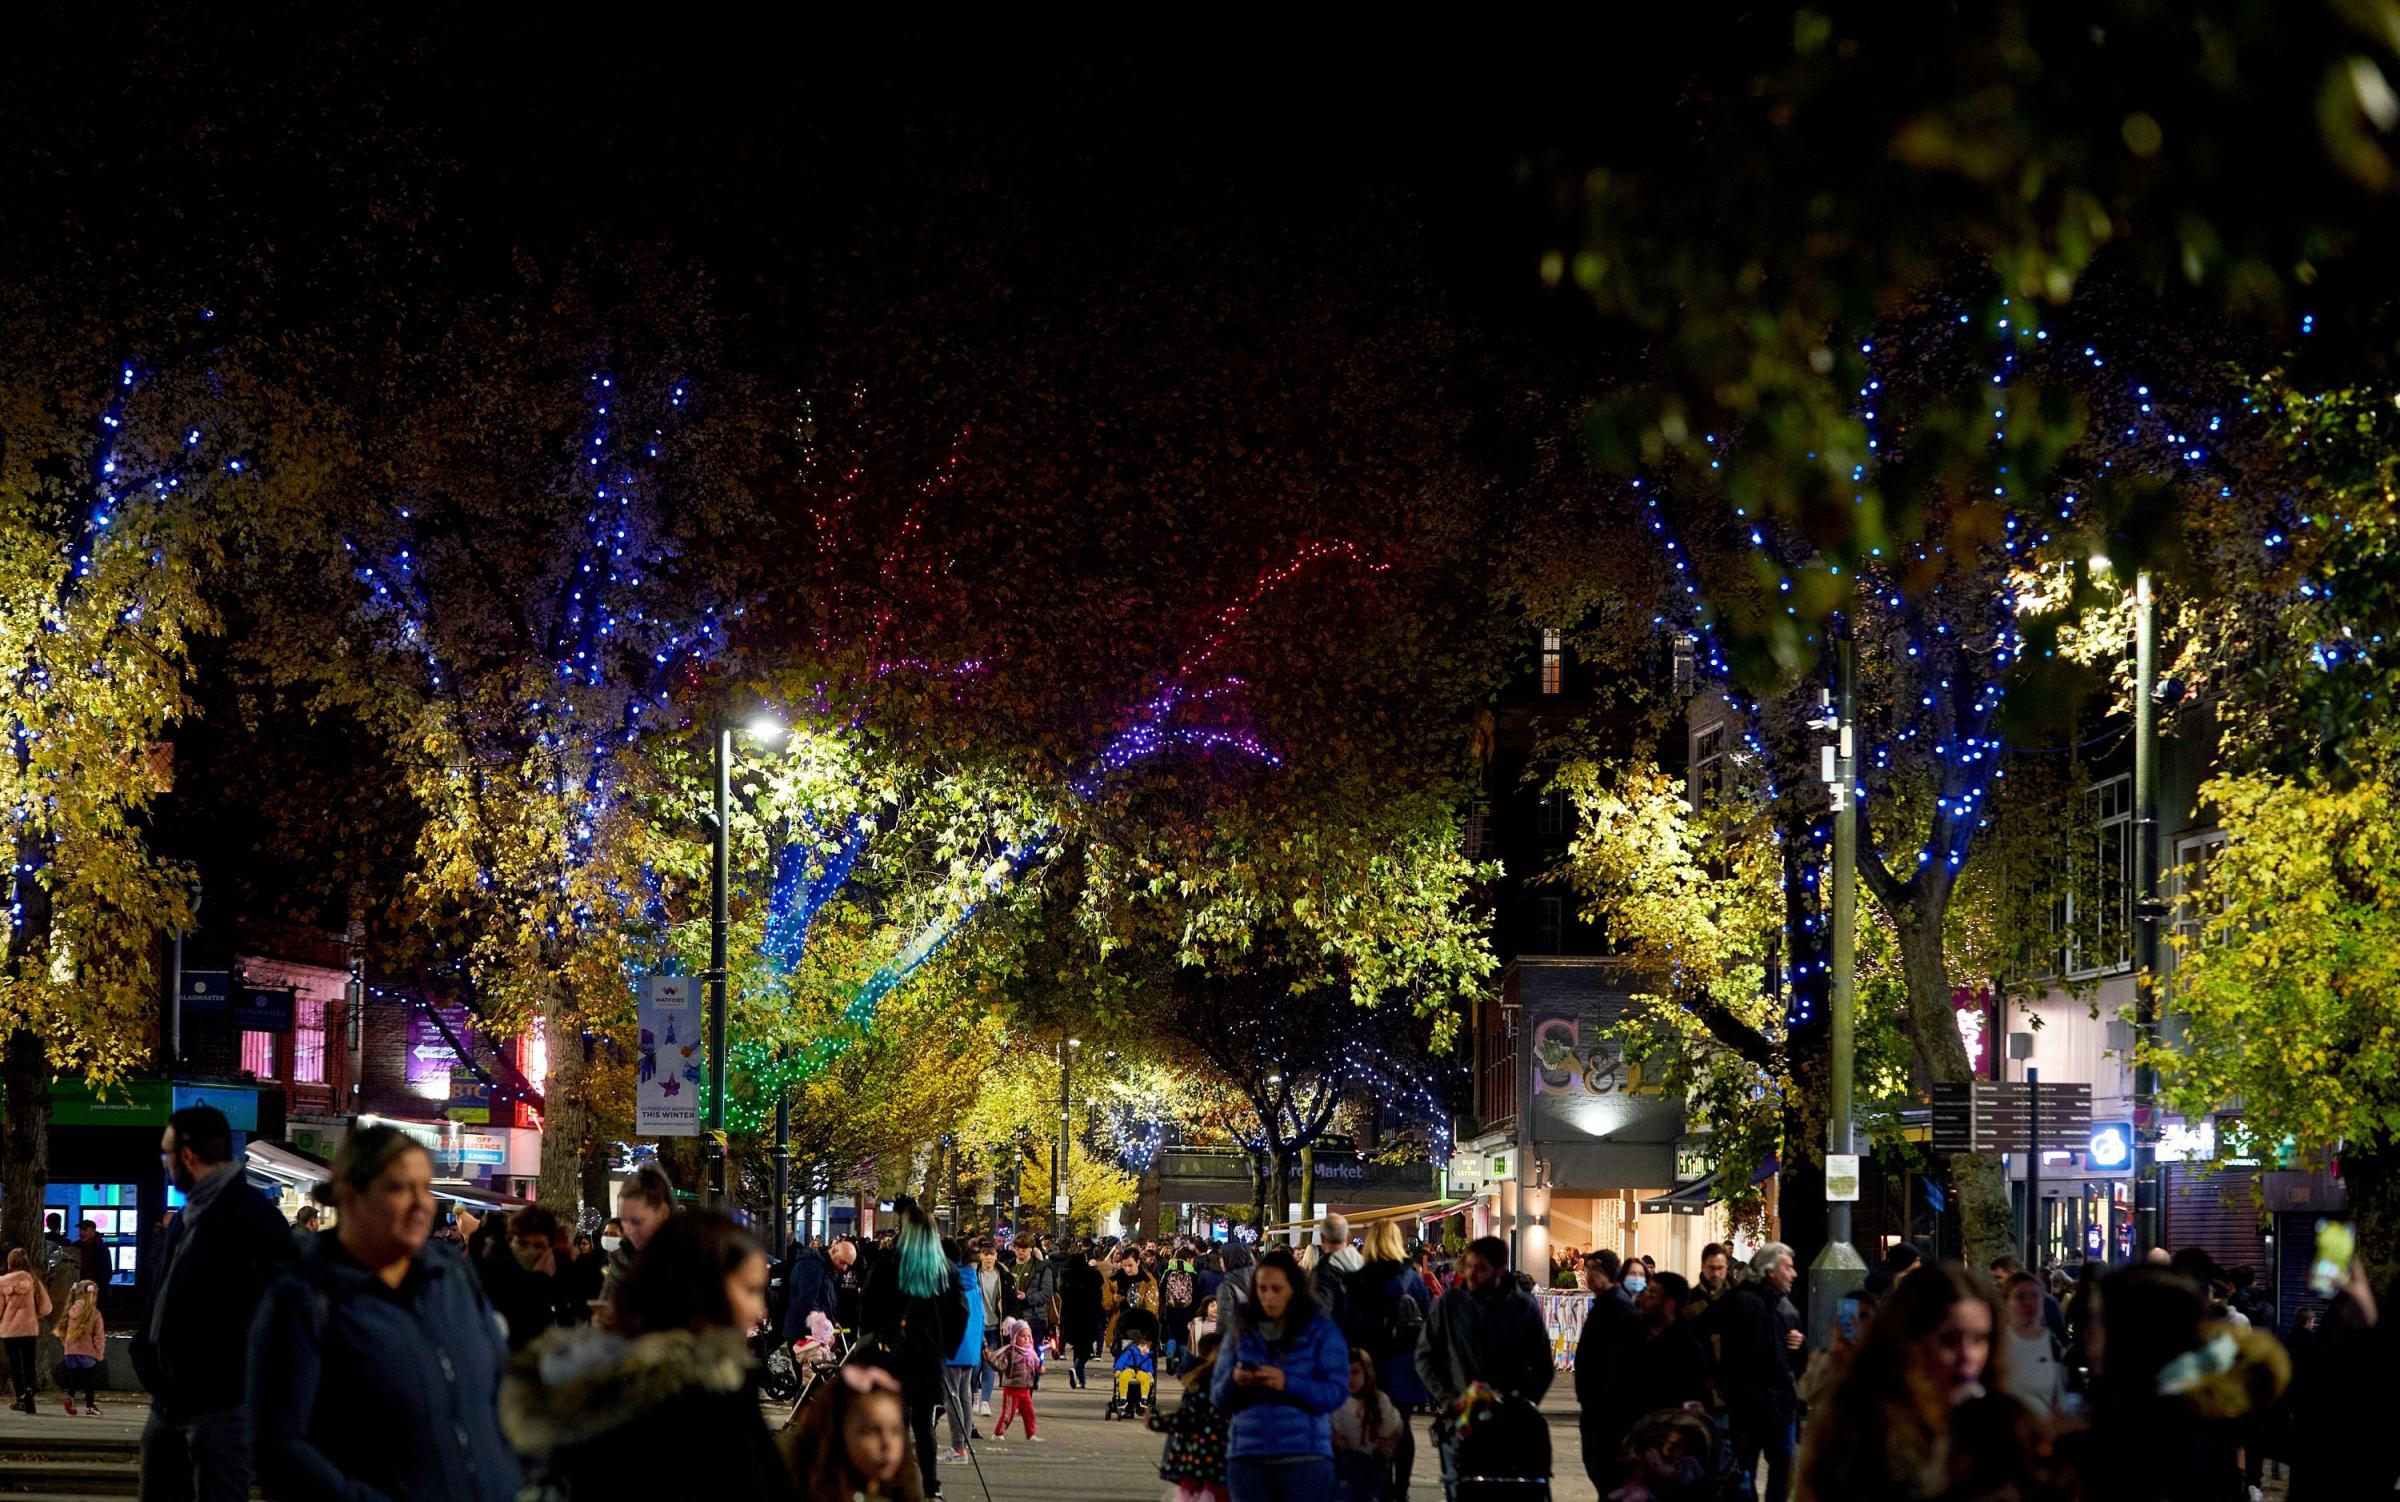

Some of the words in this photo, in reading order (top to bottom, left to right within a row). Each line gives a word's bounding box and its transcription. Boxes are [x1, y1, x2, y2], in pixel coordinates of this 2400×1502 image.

[642, 1111, 660, 1119] THIS
[662, 1111, 695, 1119] WINTER
[476, 1136, 492, 1144] OFF
[1314, 1162, 1363, 1179] Market
